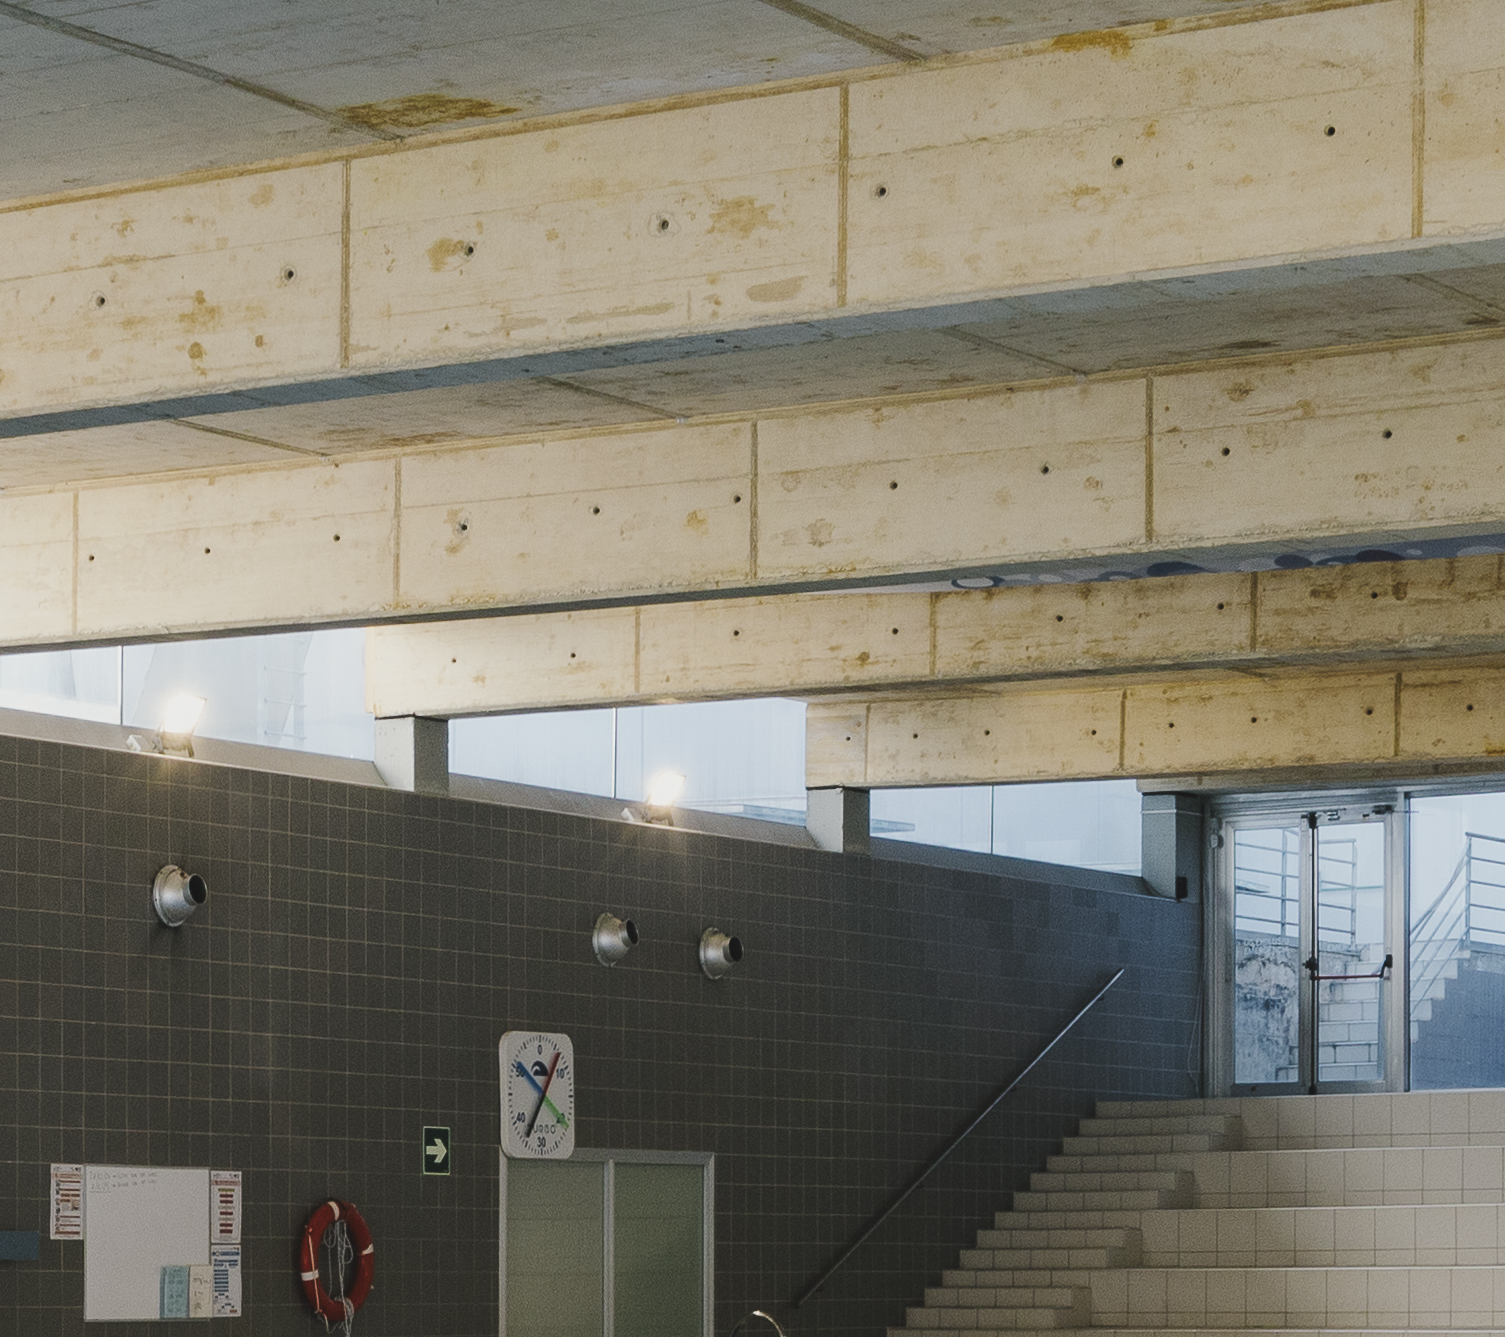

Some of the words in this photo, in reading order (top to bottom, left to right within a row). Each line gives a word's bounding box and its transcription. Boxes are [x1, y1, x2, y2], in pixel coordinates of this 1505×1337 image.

[537, 1044, 543, 1055] 0
[556, 1067, 565, 1079] 10
[516, 1112, 526, 1123] 40
[528, 1124, 556, 1134] URBO
[537, 1136, 546, 1148] 30
